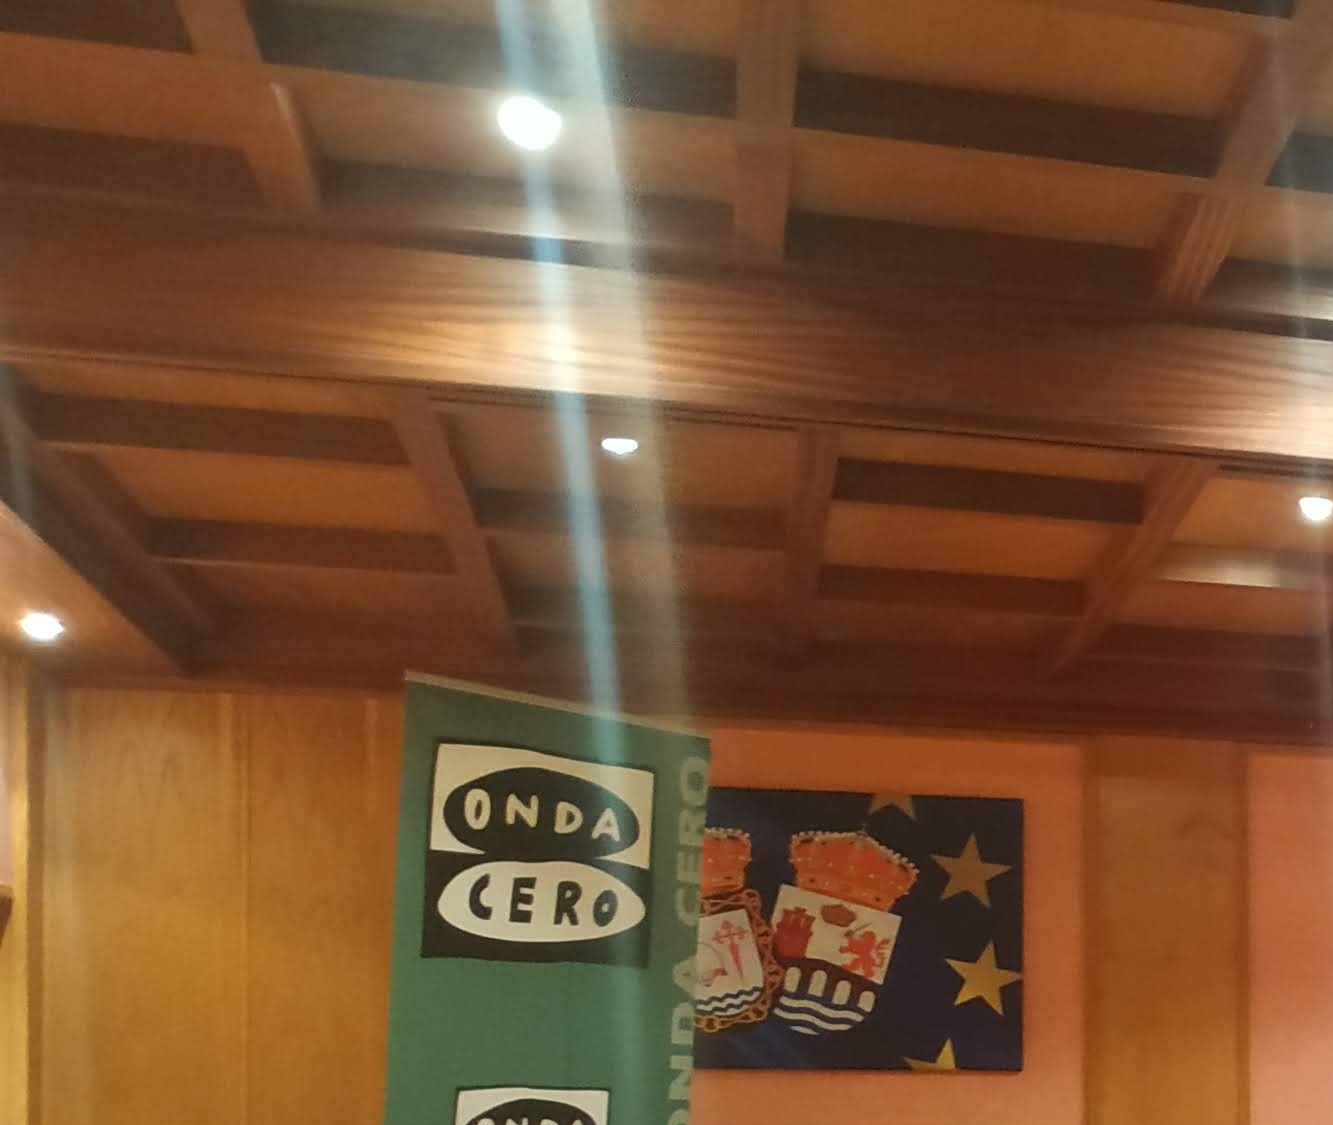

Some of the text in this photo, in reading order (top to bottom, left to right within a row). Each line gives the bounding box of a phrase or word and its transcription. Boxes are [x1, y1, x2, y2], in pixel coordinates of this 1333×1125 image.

[464, 788, 620, 842] ONDA
[674, 755, 710, 927] CERO
[469, 873, 618, 927] CERO
